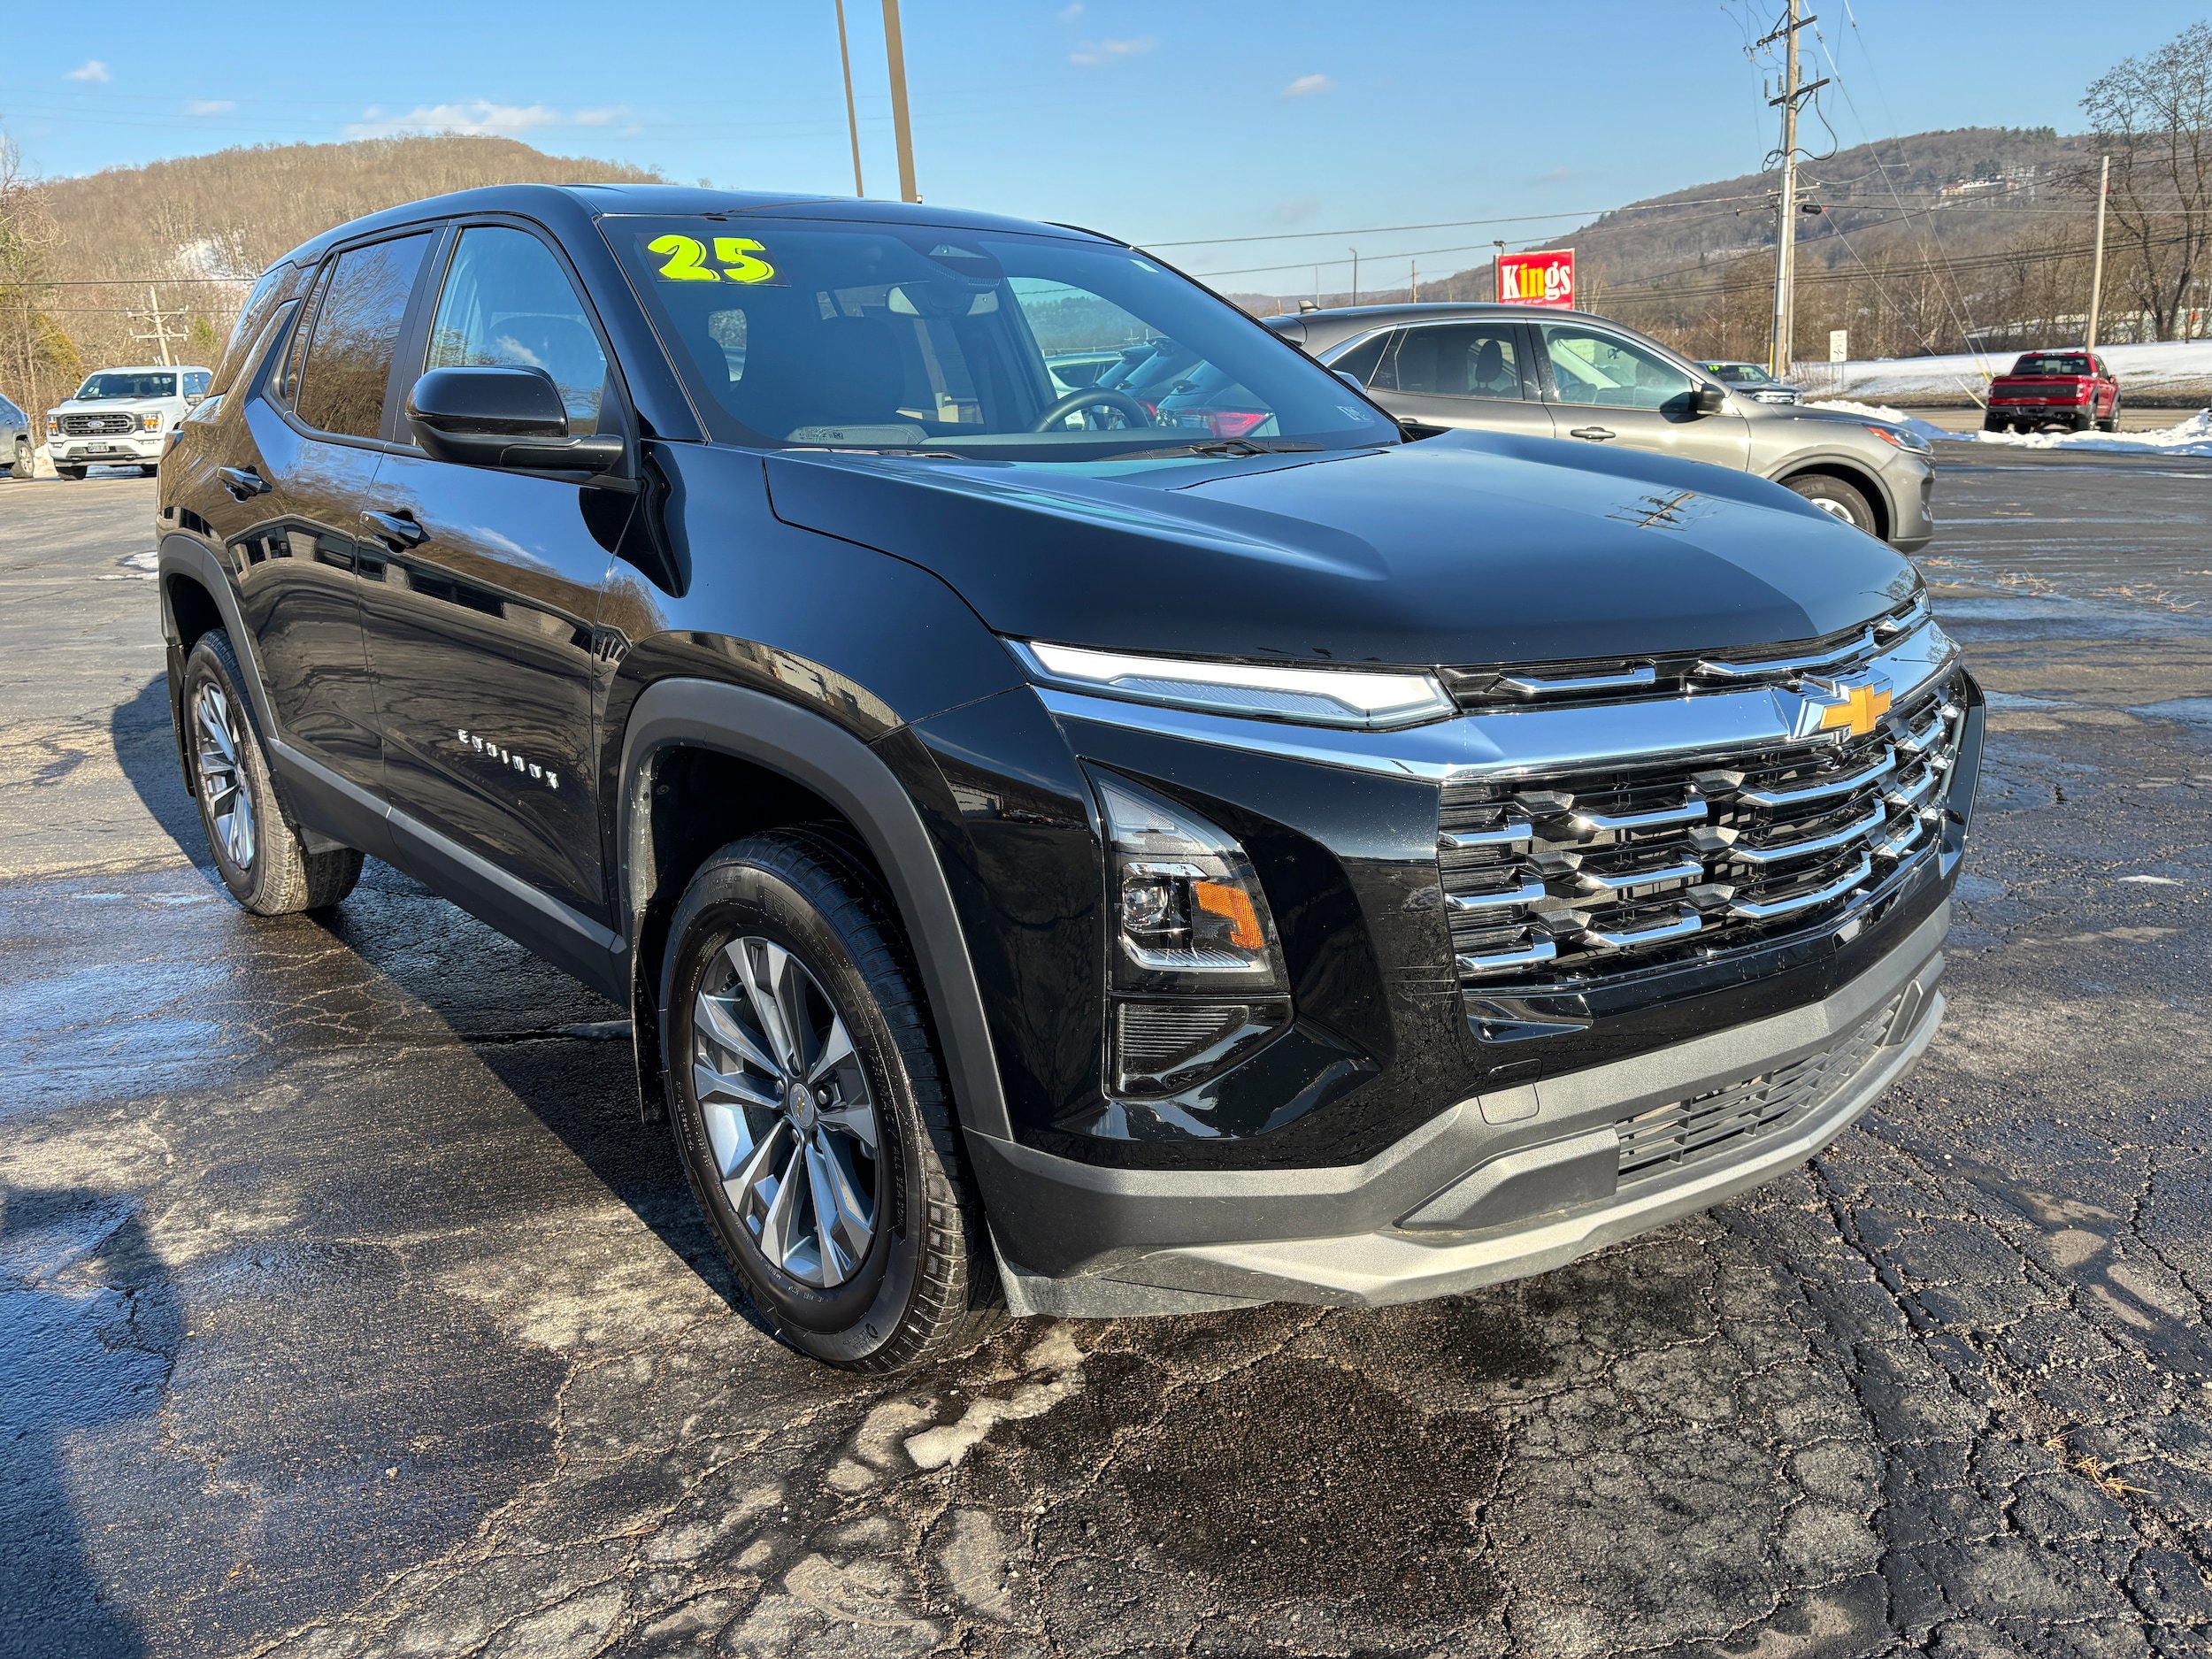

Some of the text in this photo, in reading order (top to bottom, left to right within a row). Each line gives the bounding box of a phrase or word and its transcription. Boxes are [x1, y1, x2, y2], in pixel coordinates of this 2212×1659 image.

[647, 234, 775, 283] 25
[1502, 261, 1571, 301] Kings
[457, 728, 560, 789] EQUINOX
[892, 1145, 902, 1171] ALL
[895, 1174, 904, 1228] SEASON
